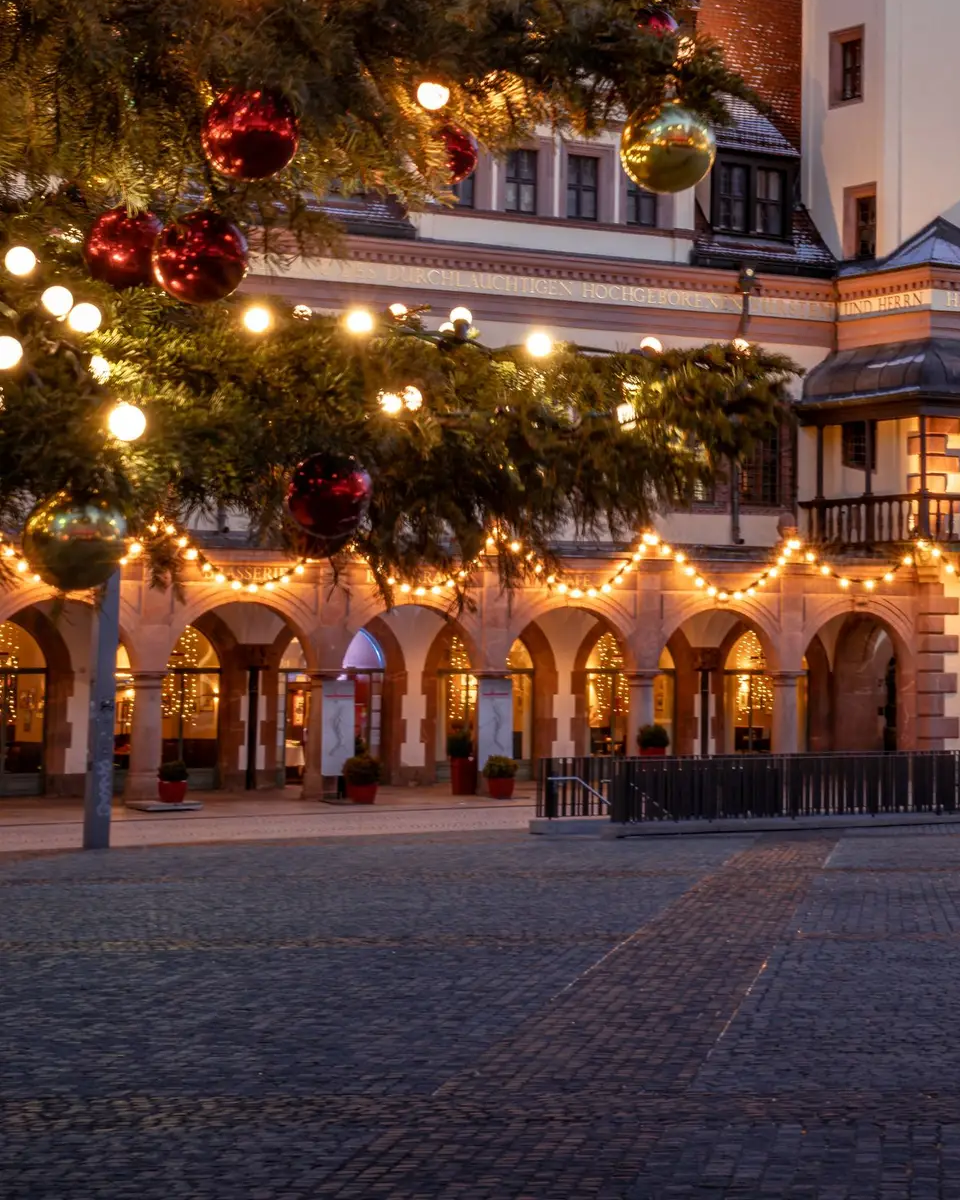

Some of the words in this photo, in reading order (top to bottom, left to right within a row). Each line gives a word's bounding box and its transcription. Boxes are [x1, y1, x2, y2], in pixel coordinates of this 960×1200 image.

[387, 265, 574, 296] DURCHLAUCHTIGEN
[583, 282, 743, 311] HOCHGEBORENEN
[844, 299, 874, 315] UND
[878, 292, 925, 311] HERRN
